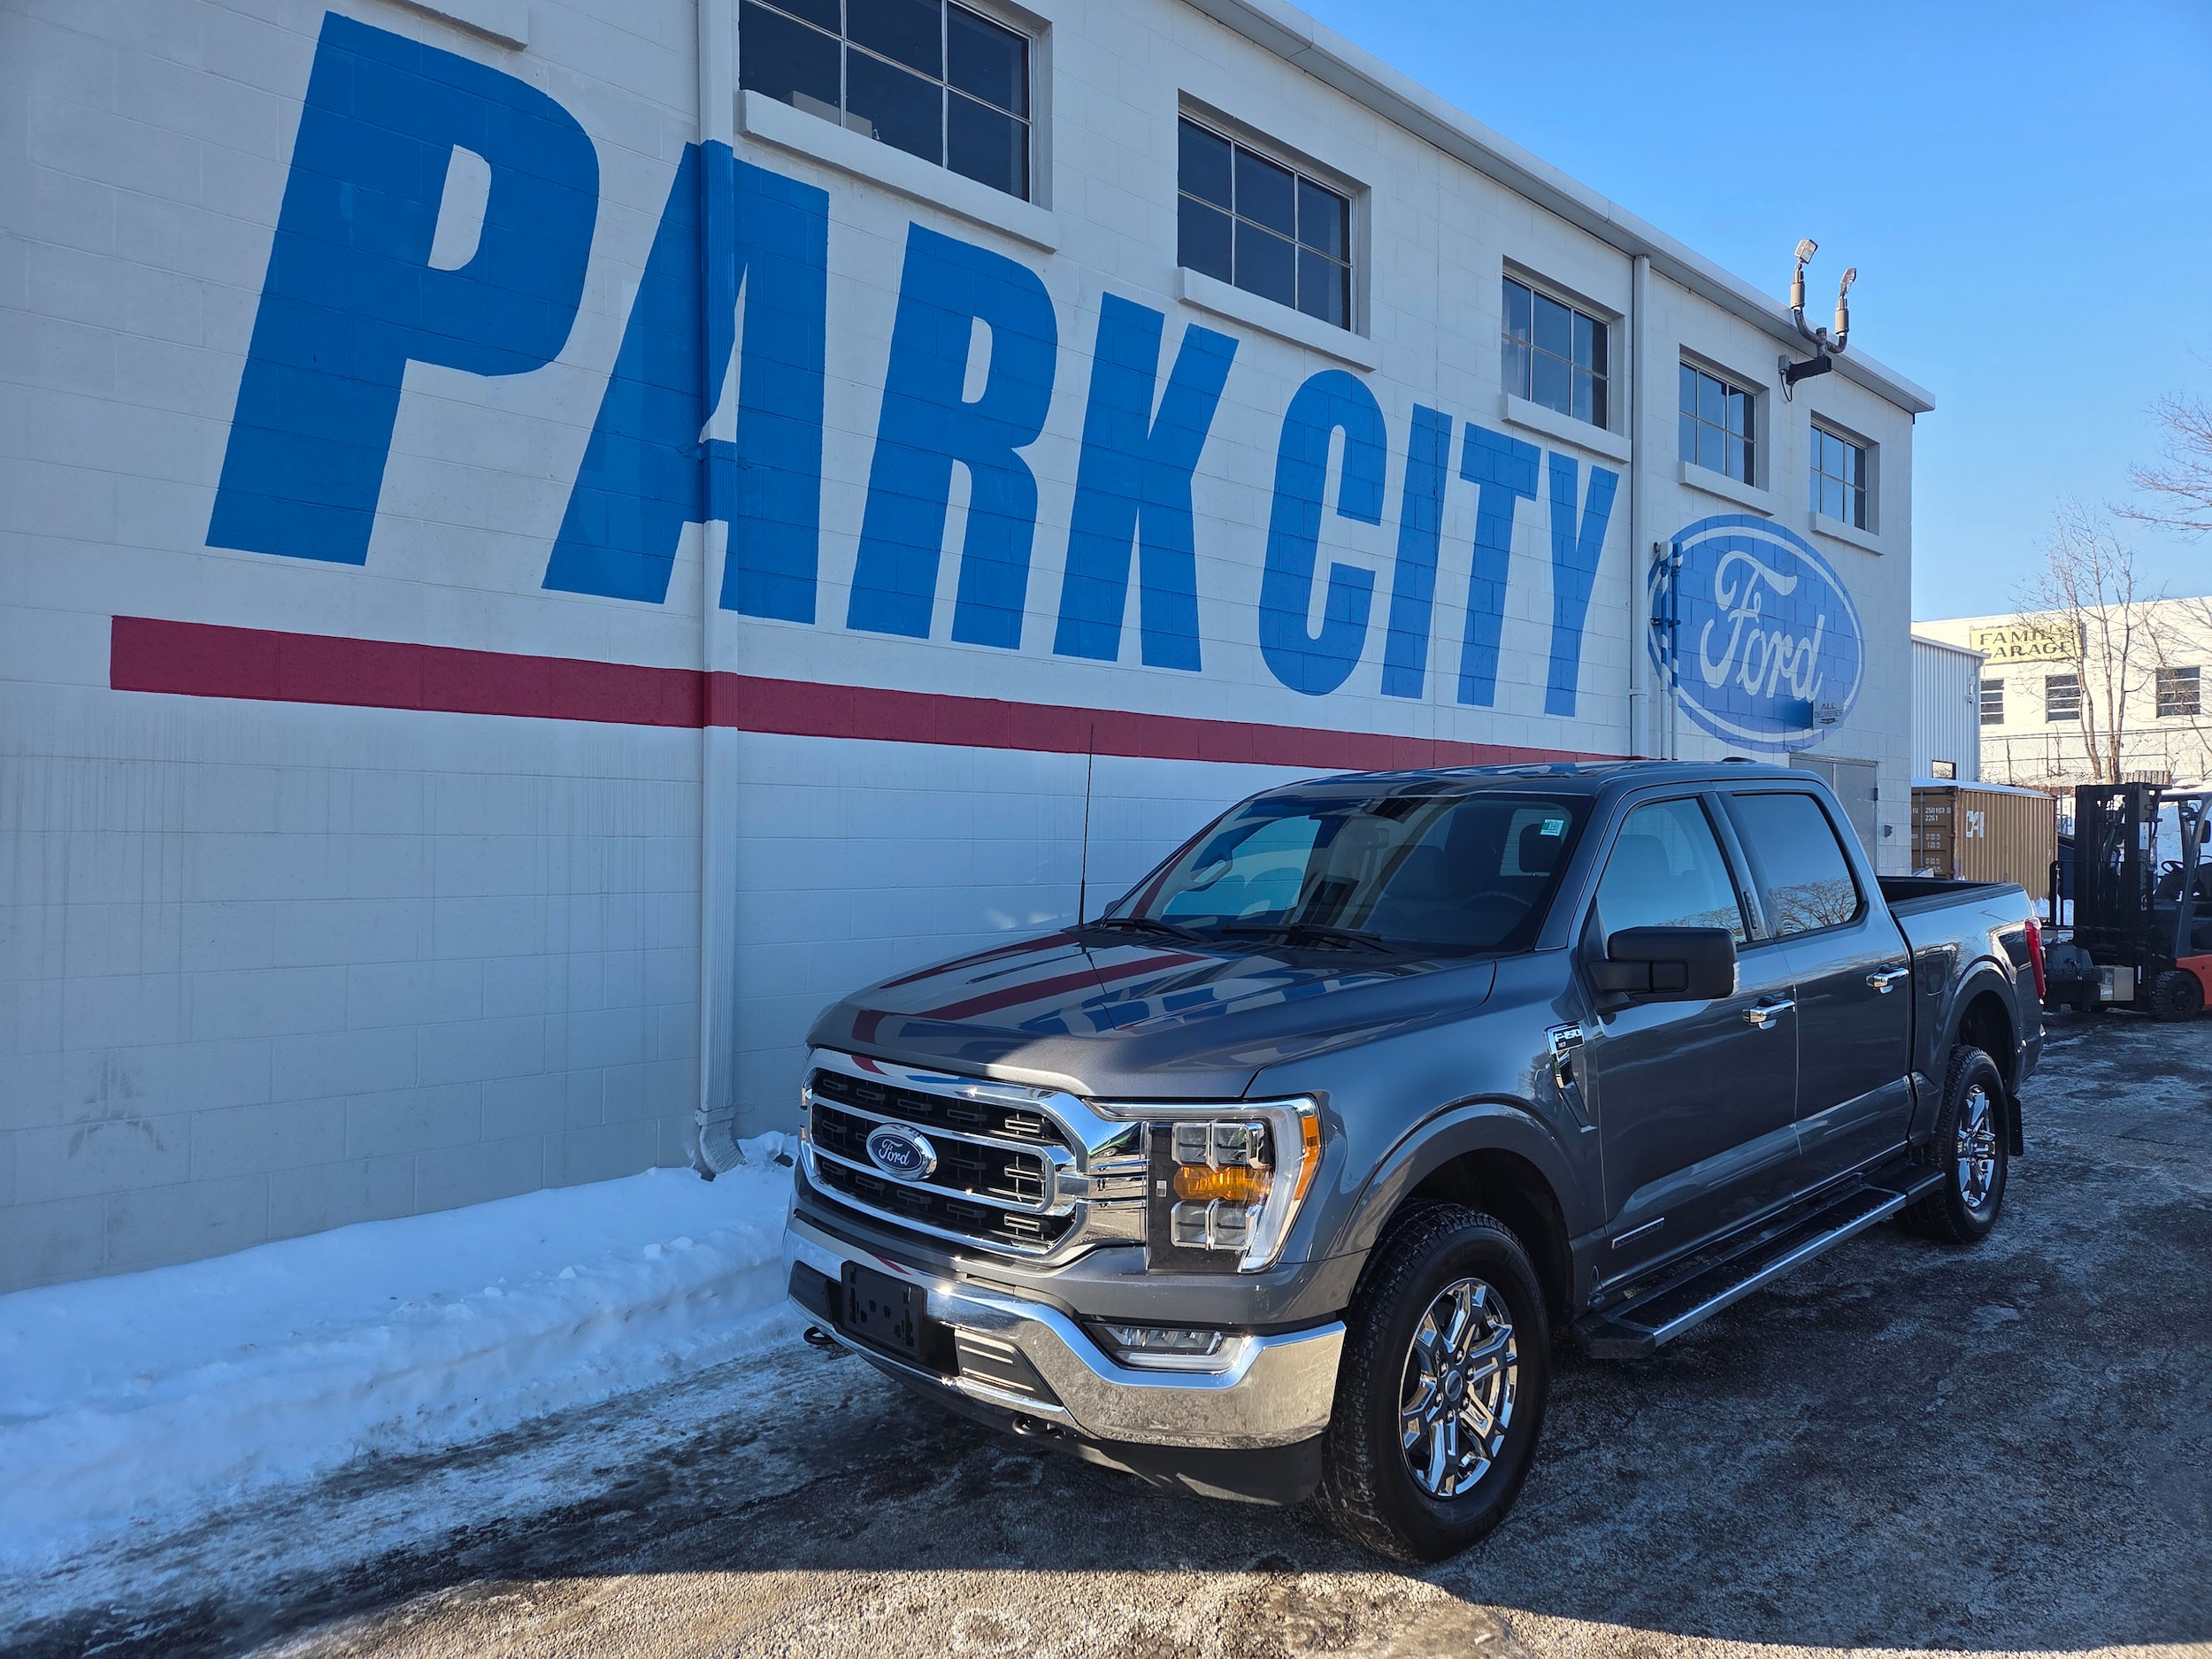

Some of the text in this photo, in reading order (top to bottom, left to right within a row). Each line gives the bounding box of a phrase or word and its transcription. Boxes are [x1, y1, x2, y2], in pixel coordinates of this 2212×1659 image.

[205, 11, 1620, 718] PARK CITY
[1700, 550, 1825, 703] Ford
[1980, 627, 2070, 645] FAMILY
[1555, 1028, 1582, 1042] F-150
[879, 1139, 910, 1166] Ford
